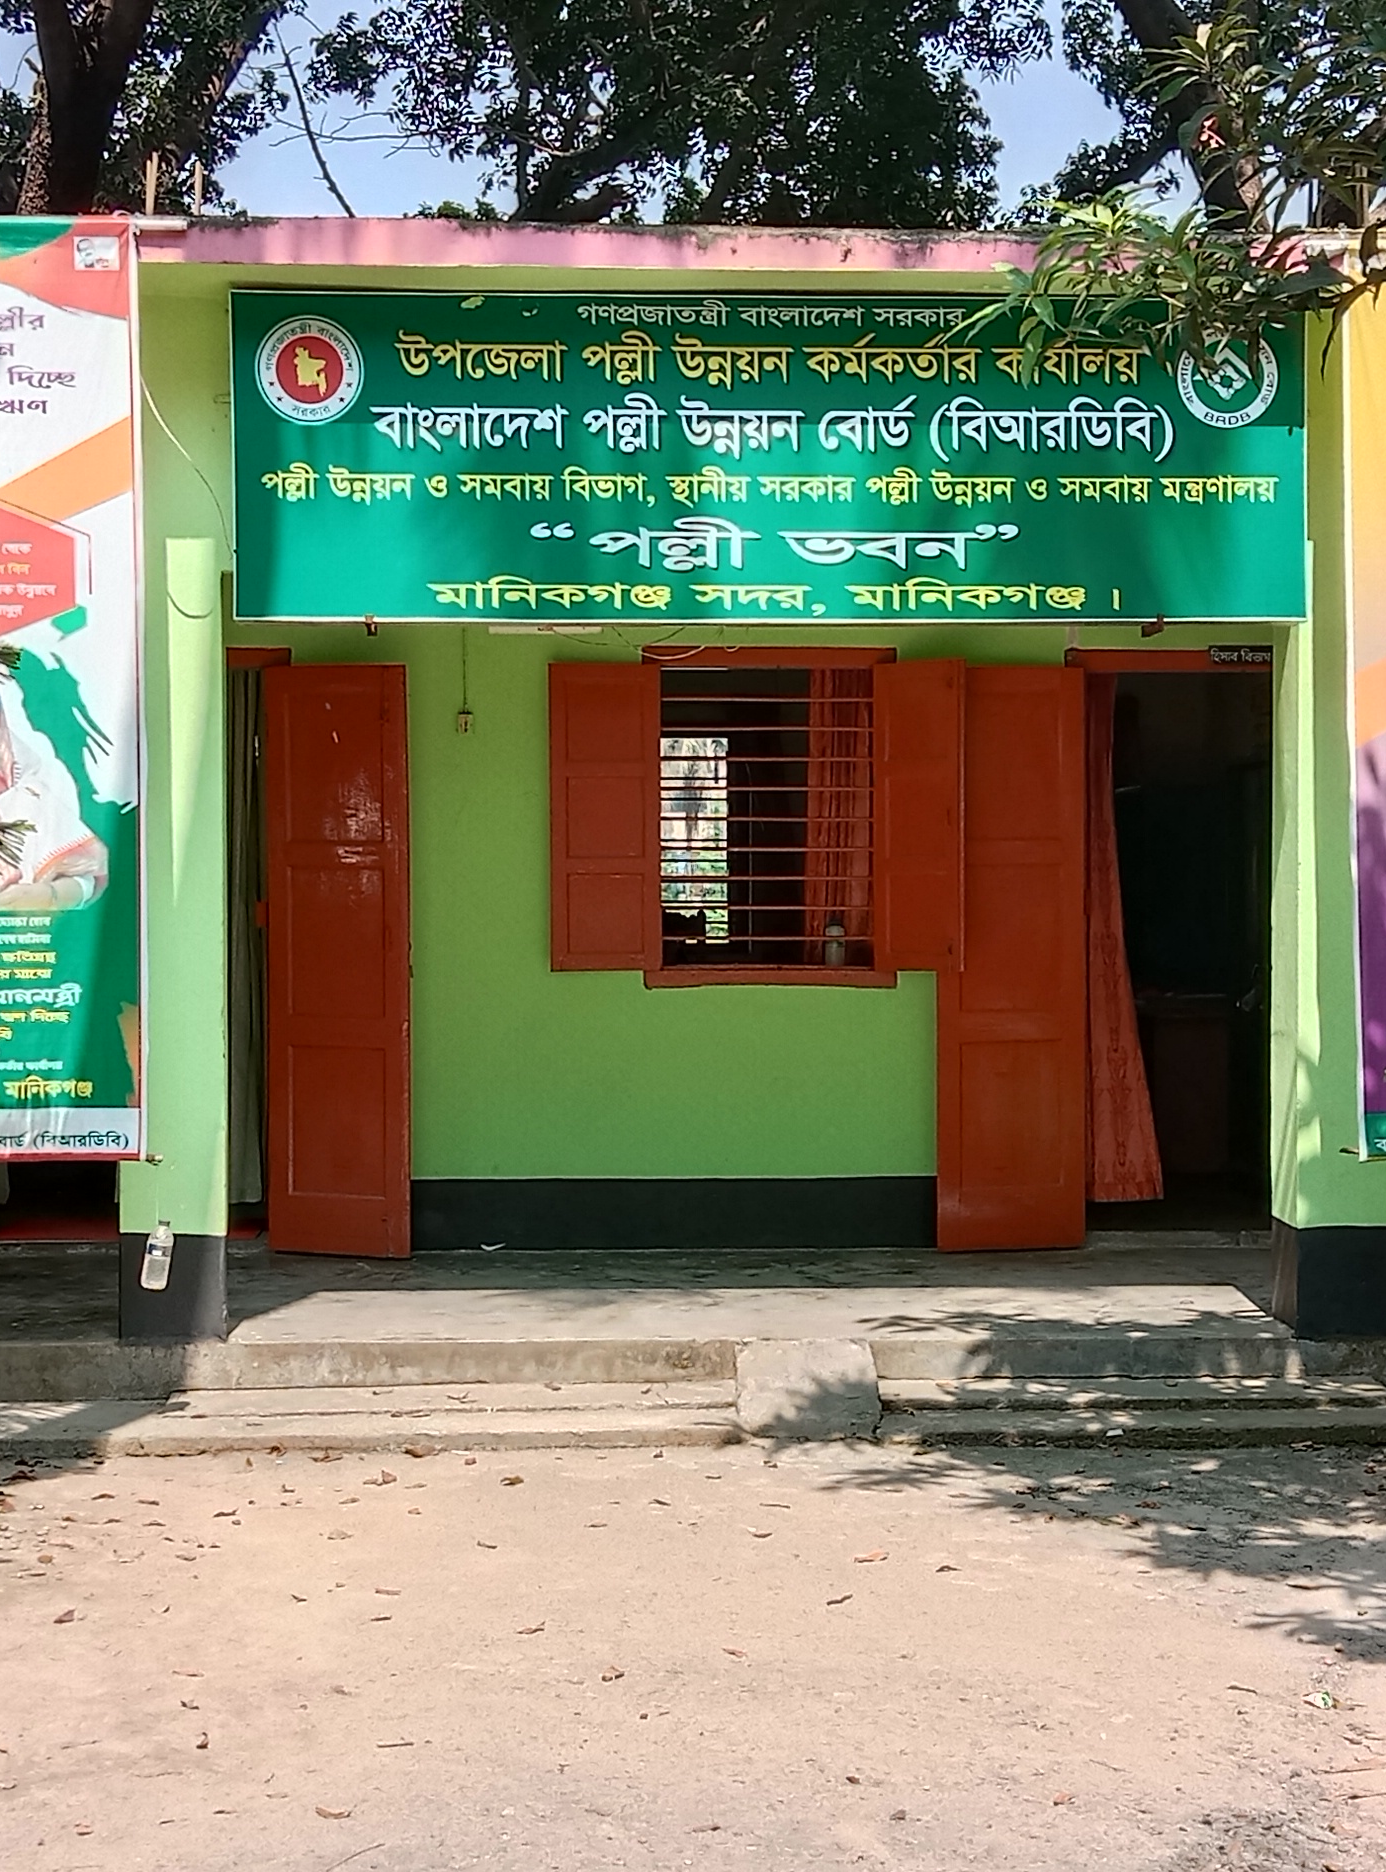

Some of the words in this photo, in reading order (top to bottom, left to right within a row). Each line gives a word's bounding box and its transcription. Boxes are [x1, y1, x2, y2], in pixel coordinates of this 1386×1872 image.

[577, 299, 731, 327] গণপ্রজাতন্ত্রী
[738, 304, 866, 328] বাংলাদেশ
[872, 305, 966, 328] সরকার
[395, 330, 568, 382] উপজেলা
[582, 330, 662, 385] পল্লী
[671, 333, 794, 390] উন্নয়ন
[802, 333, 982, 384] কর্মকর্তার
[8, 364, 77, 389] দিচ্ছে
[291, 404, 332, 418] সরকার
[1203, 411, 1252, 426] BRDB
[370, 402, 570, 452] বাংলাদেশ
[583, 393, 667, 453] পল্লী
[676, 395, 805, 460] উন্নয়ন
[818, 395, 917, 453] বোর্ড
[929, 396, 1175, 463] (বিআরডিবি)
[262, 462, 320, 503] পল্লী
[326, 465, 415, 505] উন্নয়ন
[424, 474, 448, 498] ও
[457, 473, 554, 501] সমবায়
[561, 466, 656, 507] বিভাগ,
[666, 466, 751, 507] স্থানীয়
[757, 475, 856, 503] সরকার
[866, 467, 923, 506] পল্লী
[928, 468, 1016, 508] উন্নয়ন
[1025, 477, 1049, 500] ও
[1057, 475, 1153, 504] সমবায়
[1159, 475, 1280, 505] মন্ত্রণালয়
[426, 575, 673, 610] মানিকগঞ্জ
[689, 583, 827, 616] সদর,
[844, 577, 1087, 612] মানিকগঞ্জ
[1210, 647, 1239, 663] হিসাব
[3, 1075, 93, 1101] মানিকগঞ্জ
